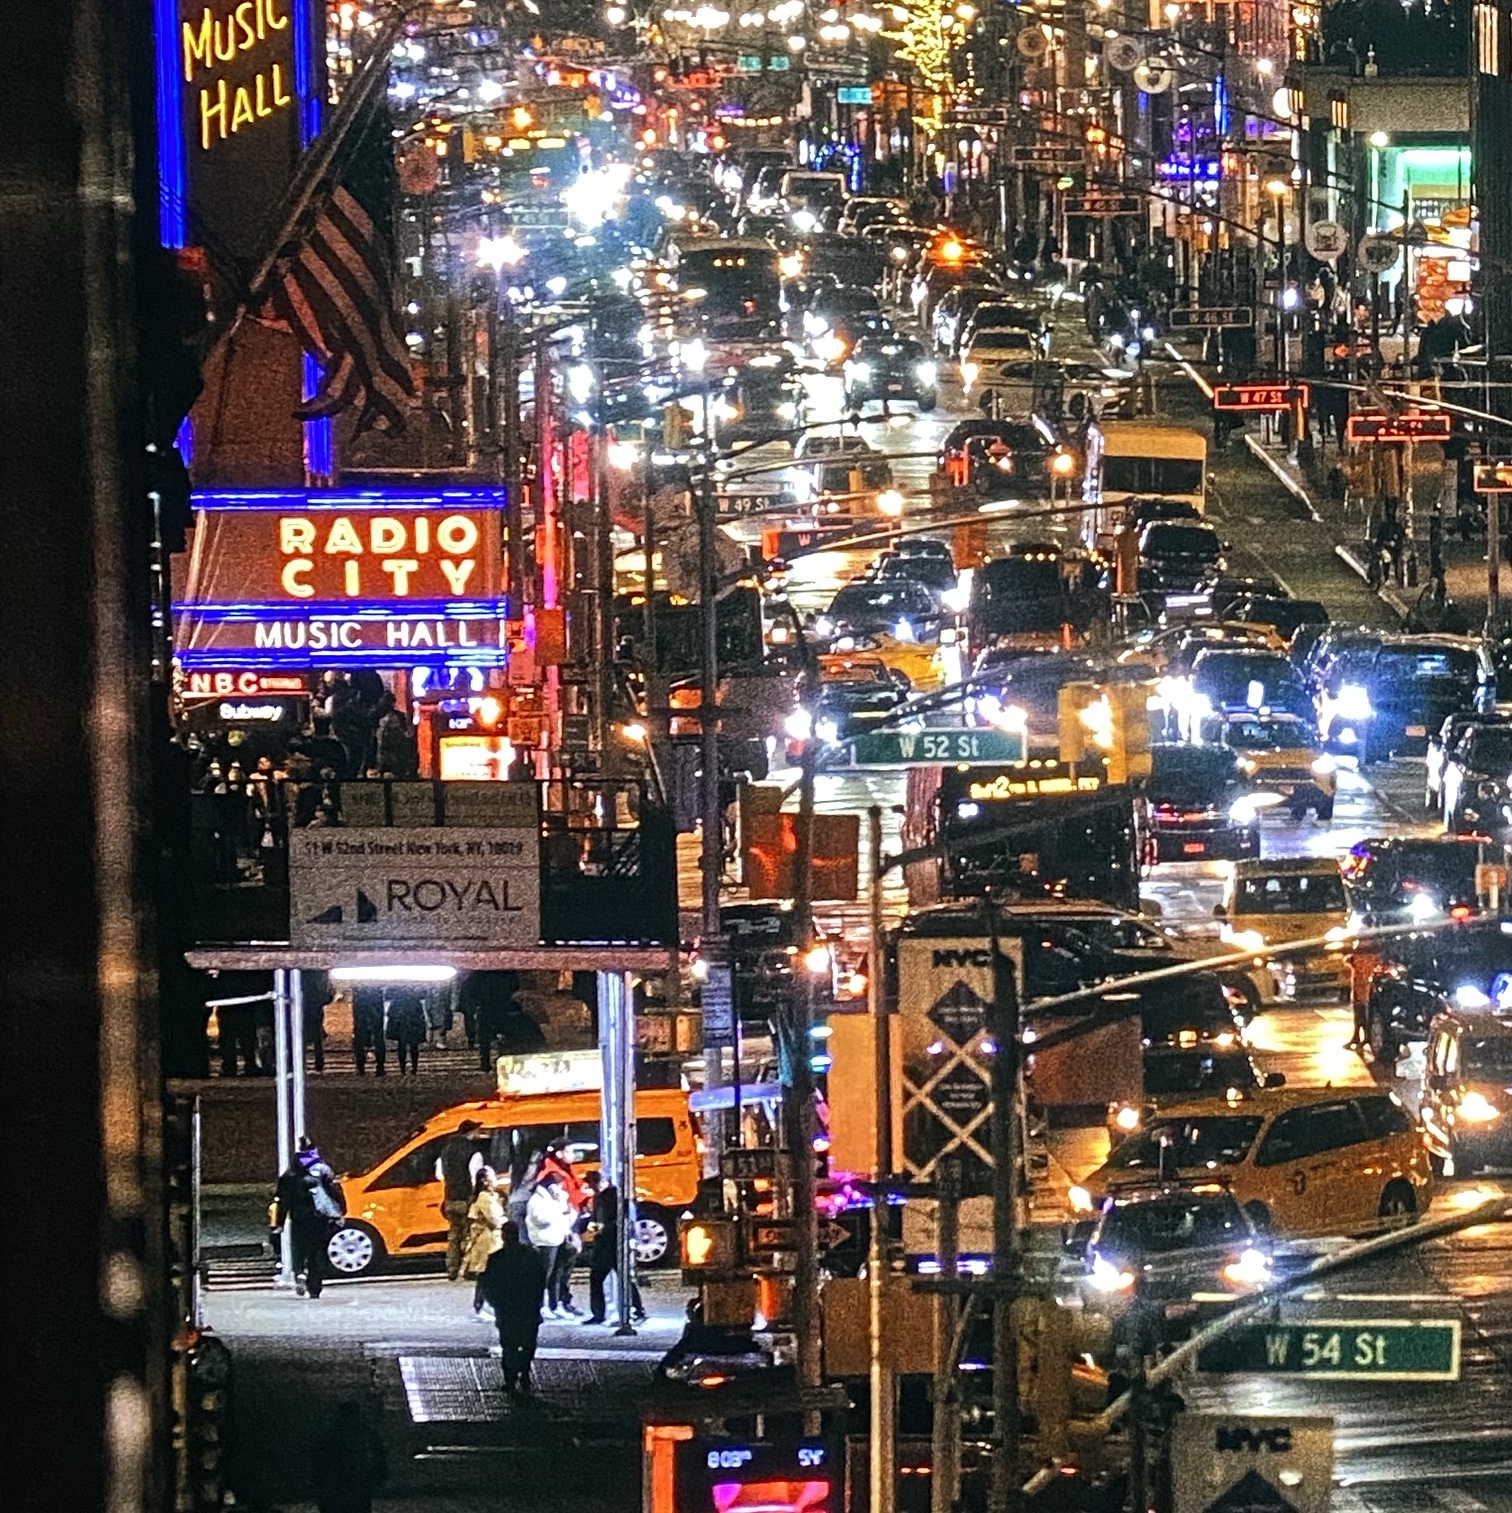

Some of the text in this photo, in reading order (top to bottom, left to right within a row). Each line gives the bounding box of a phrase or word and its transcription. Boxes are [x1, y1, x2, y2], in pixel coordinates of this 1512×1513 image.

[200, 63, 290, 150] HALL
[717, 497, 770, 513] W 49 St
[279, 515, 479, 555] RADIO
[280, 558, 477, 597] CITY
[254, 621, 478, 649] MUSIC HALL
[190, 671, 259, 694] NBC
[220, 702, 284, 723] Subway
[899, 736, 980, 759] W 52 St
[335, 841, 366, 856] 52nd
[366, 841, 402, 856] Street
[386, 878, 524, 912] ROYAL
[1266, 1332, 1388, 1366] W 54 St
